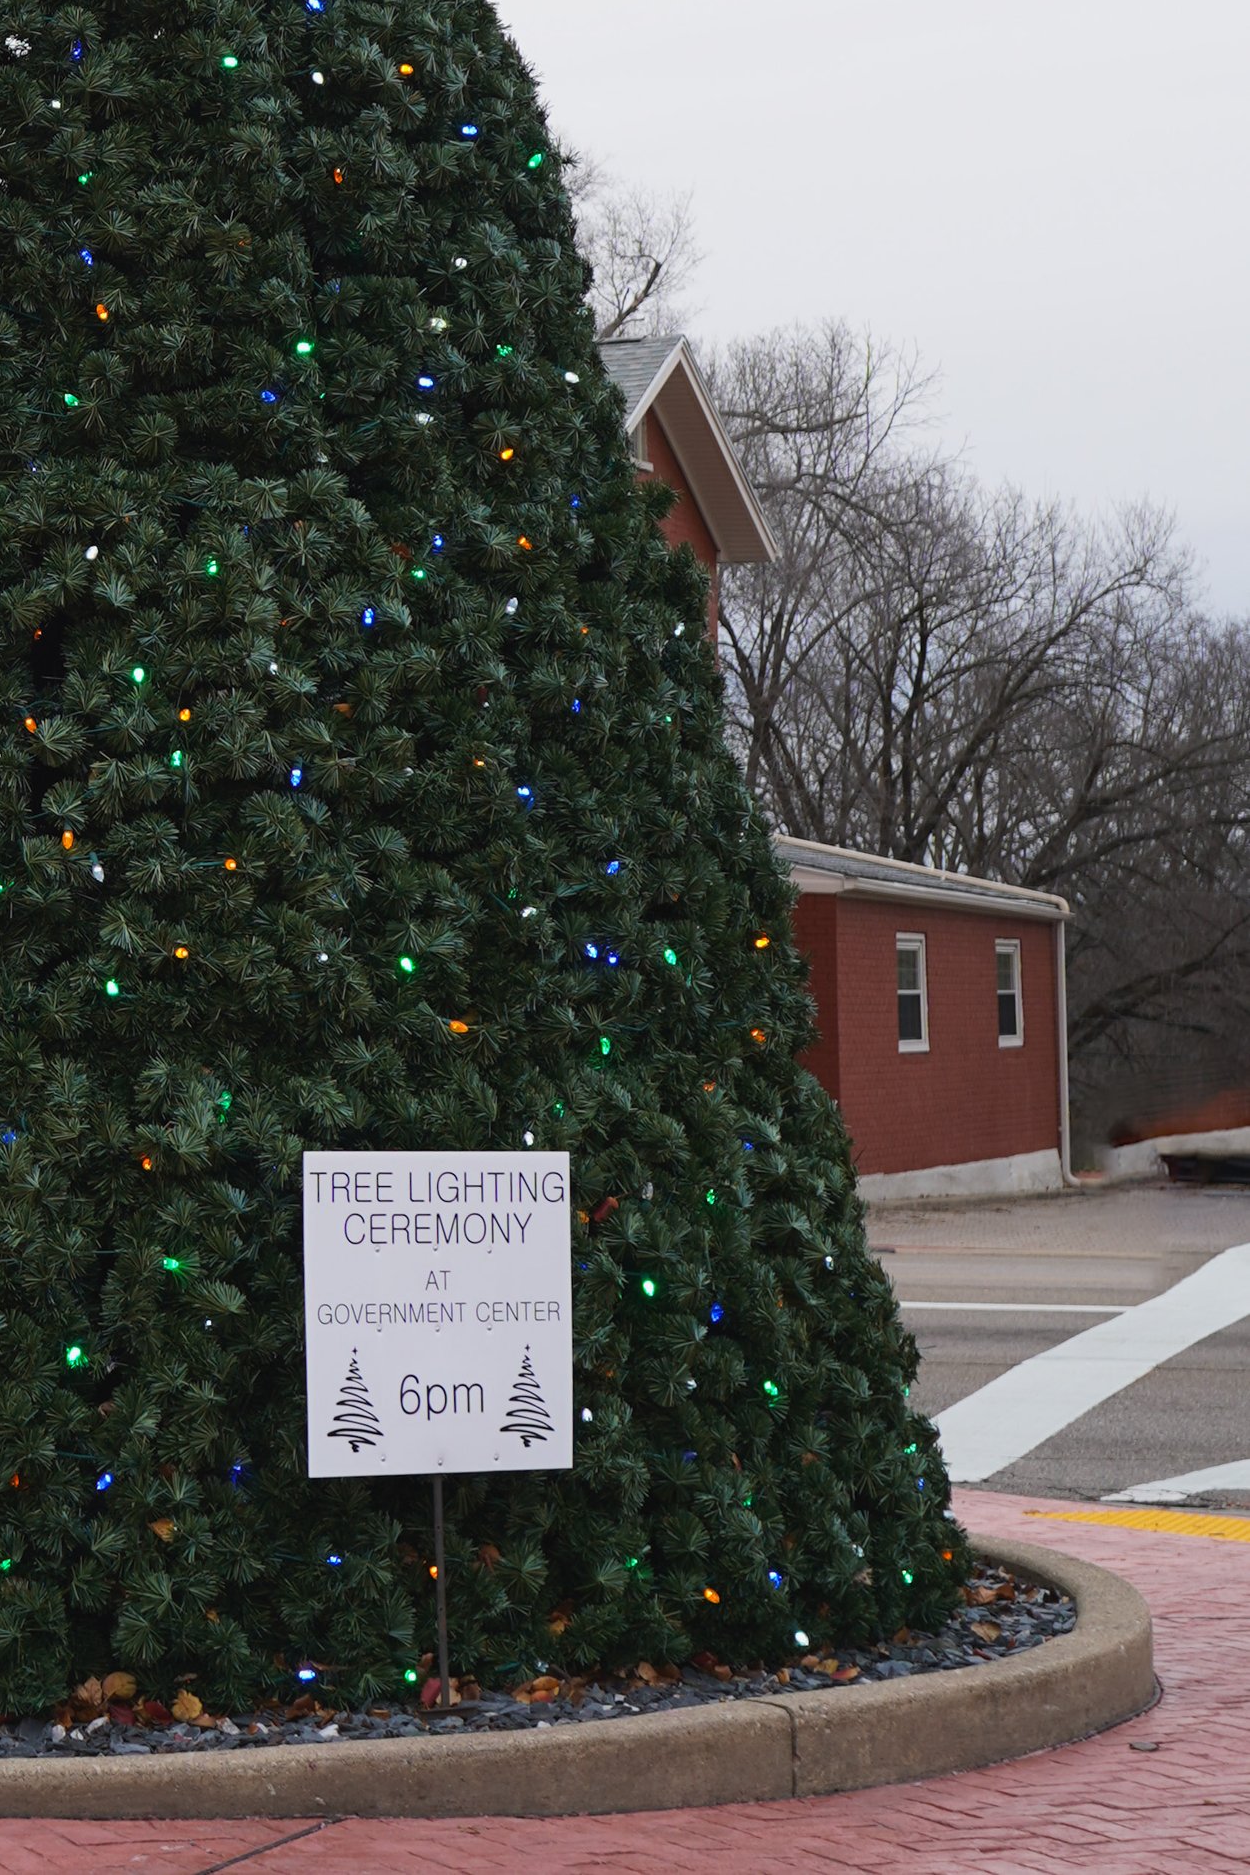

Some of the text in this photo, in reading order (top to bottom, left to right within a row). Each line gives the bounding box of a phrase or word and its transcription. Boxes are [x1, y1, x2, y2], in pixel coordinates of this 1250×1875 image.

[310, 1171, 565, 1203] TREE LIGHTING
[344, 1212, 533, 1245] CEREMONY
[425, 1270, 452, 1291] AT
[317, 1301, 561, 1325] GOVERNMENT CENTER
[399, 1374, 485, 1421] 6pm
